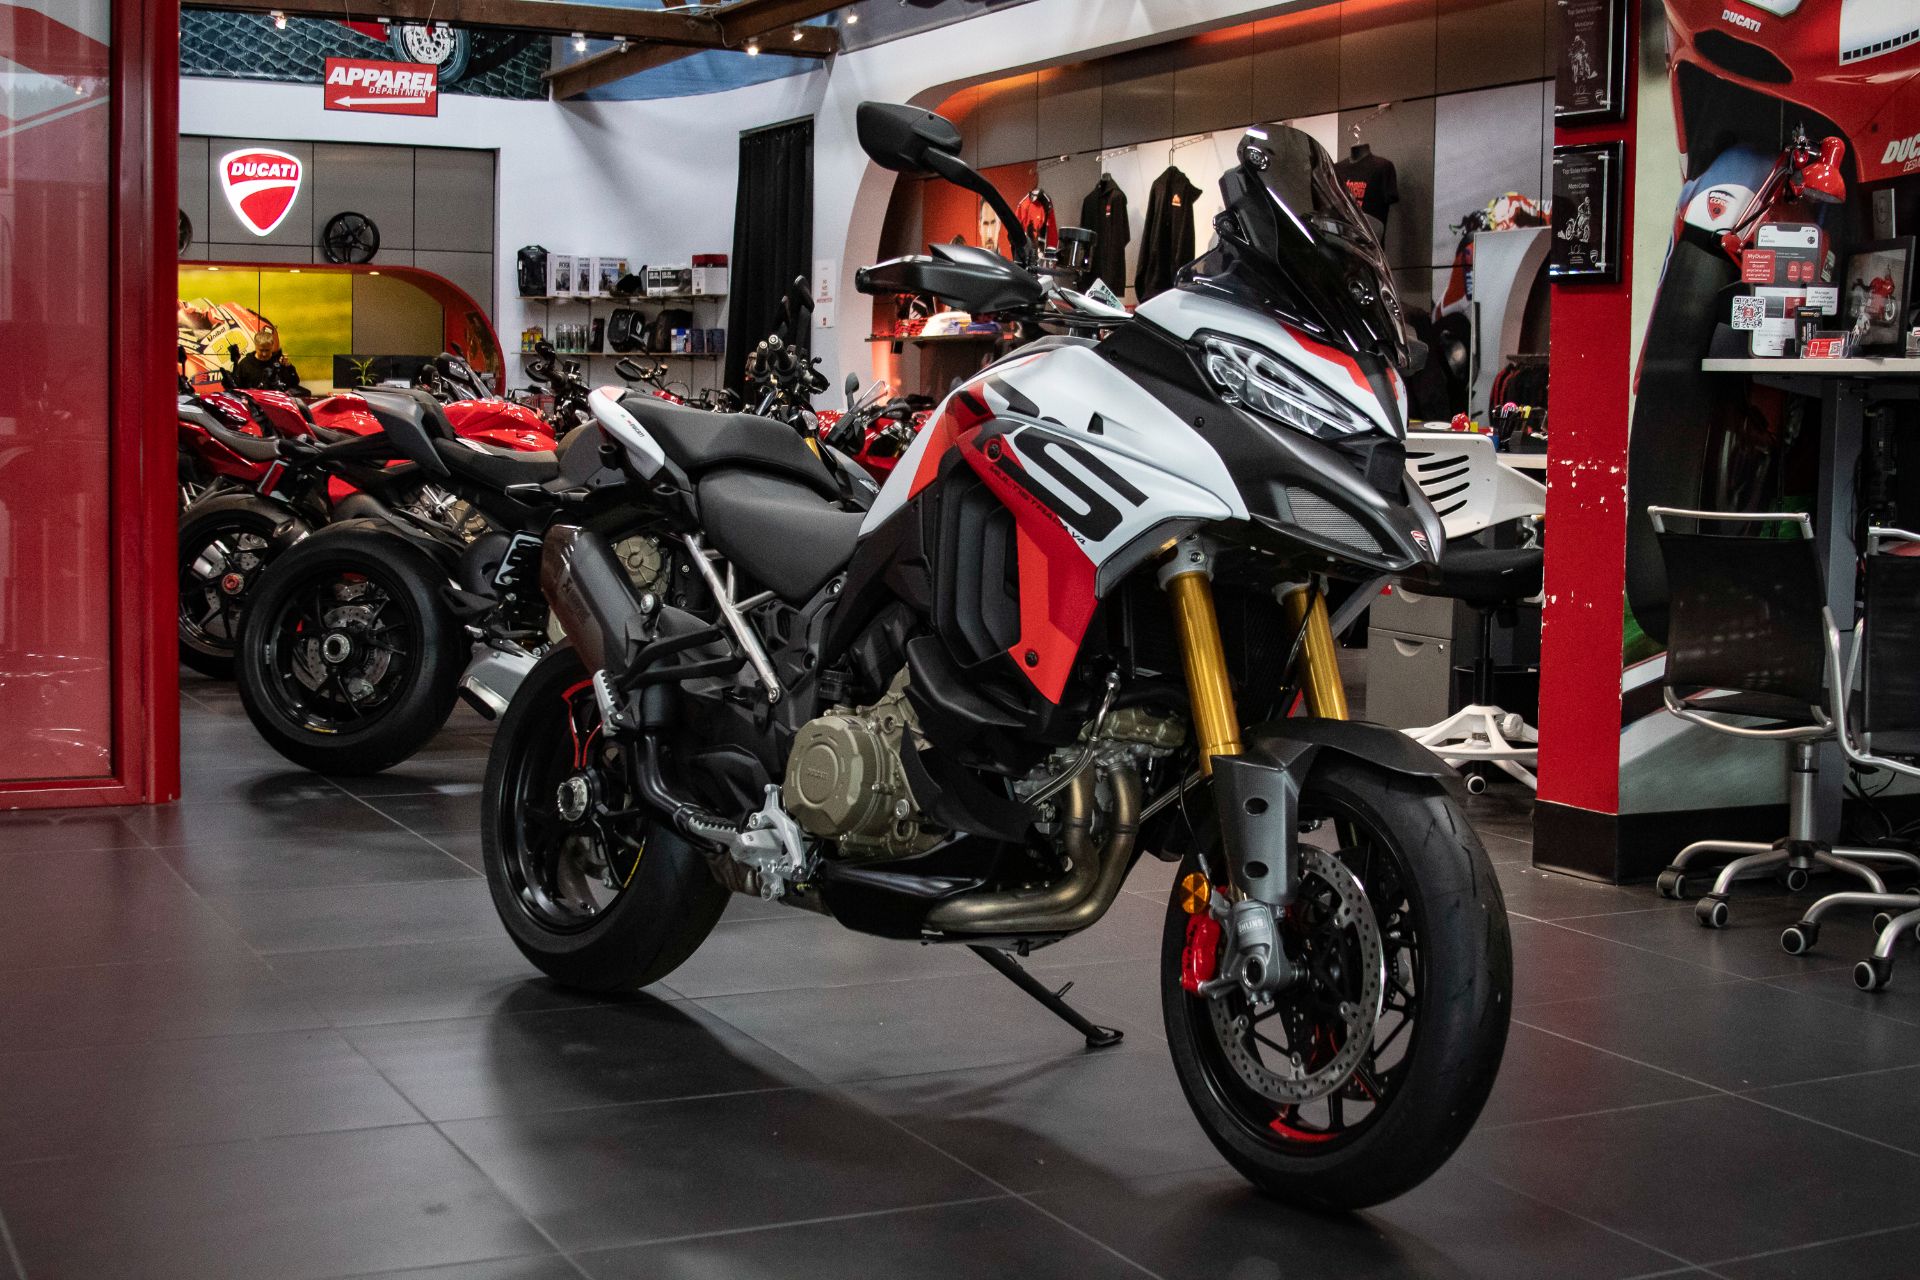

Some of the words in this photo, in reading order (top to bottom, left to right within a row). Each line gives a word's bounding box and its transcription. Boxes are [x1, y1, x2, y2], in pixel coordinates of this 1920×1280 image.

[1721, 9, 1761, 33] DUCATI
[327, 66, 436, 92] APPAREL
[369, 86, 432, 97] DEPARTMENT
[230, 162, 297, 177] DUCATI
